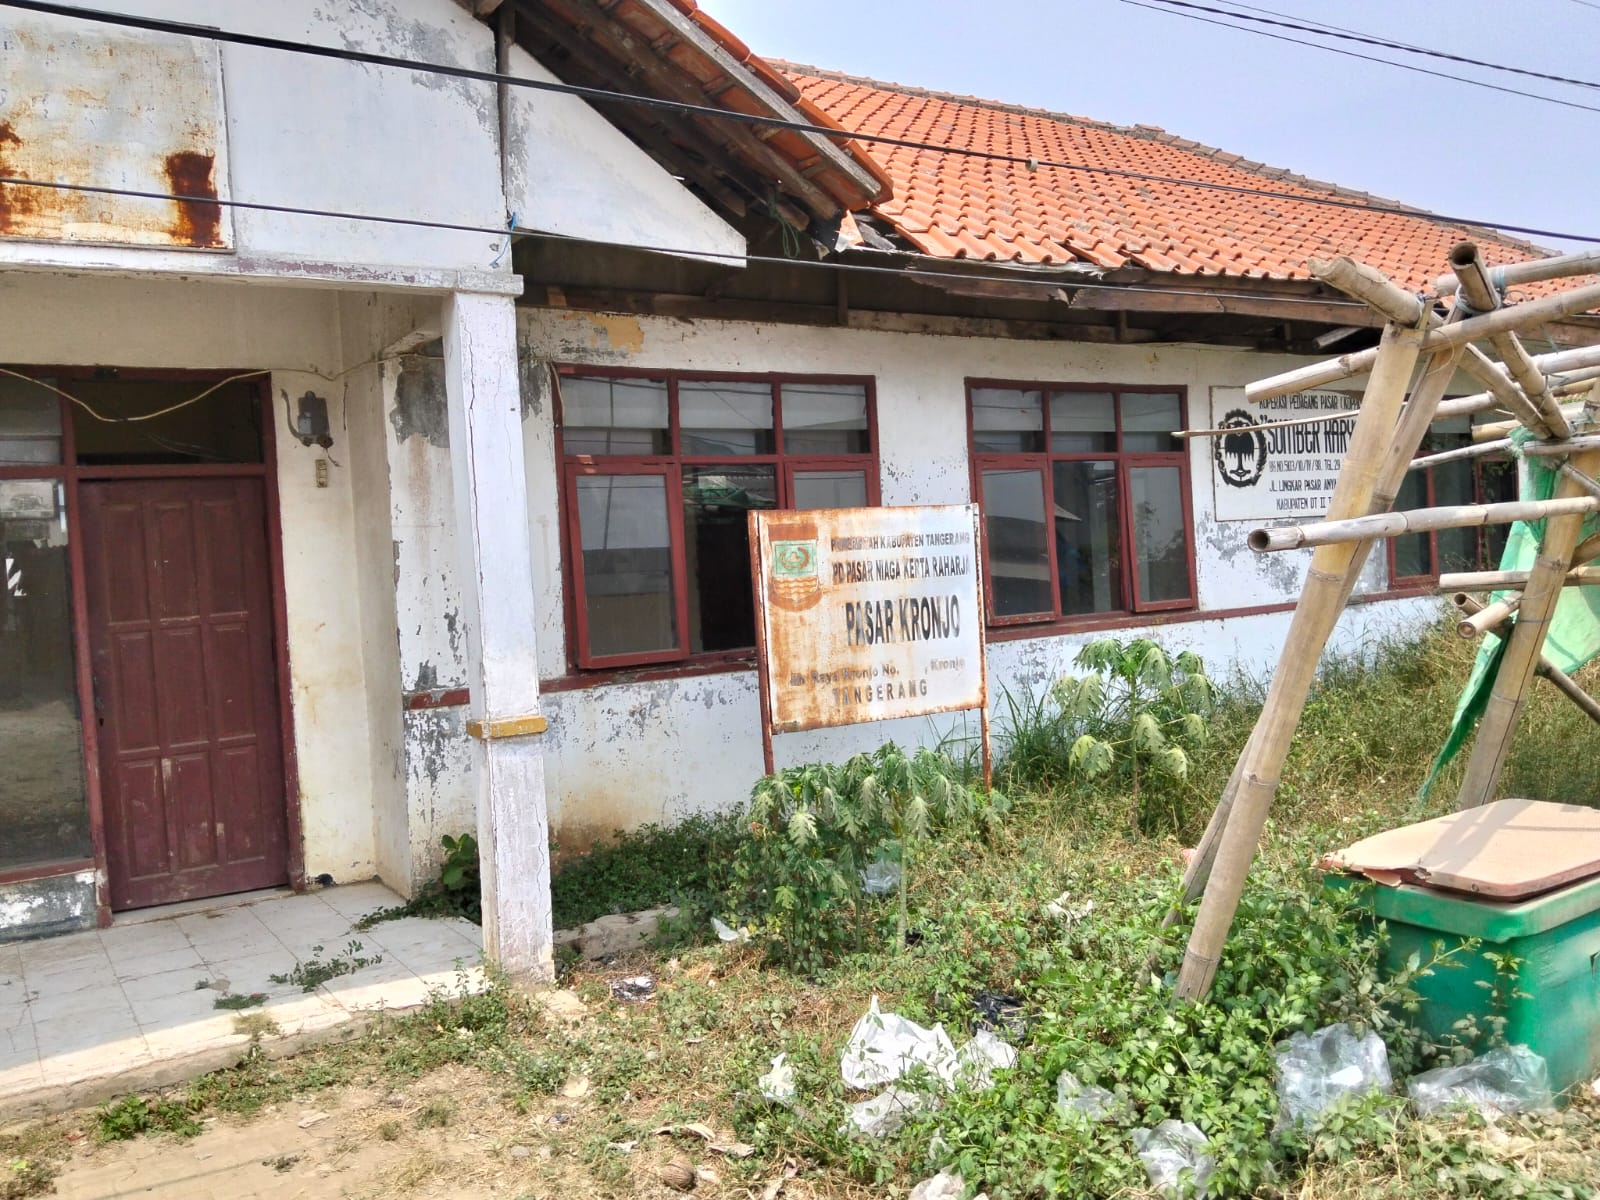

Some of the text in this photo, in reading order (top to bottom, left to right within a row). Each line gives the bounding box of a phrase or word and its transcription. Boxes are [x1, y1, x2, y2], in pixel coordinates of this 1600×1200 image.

[1290, 393, 1318, 409] PEDAGANG
[1320, 394, 1338, 409] PASAR
[1324, 418, 1356, 453] KARY
[1279, 479, 1302, 491] LINGKAR
[1304, 478, 1321, 491] PASAR
[1276, 497, 1308, 510] KABUPATEN
[926, 531, 970, 547] TANGERANG
[832, 561, 845, 585] PD
[846, 560, 874, 583] PASAR
[876, 558, 901, 581] NIAGA
[903, 557, 930, 579] KERTA
[846, 594, 961, 646] PASAR KRONJO
[832, 678, 928, 706] TANGERANG
